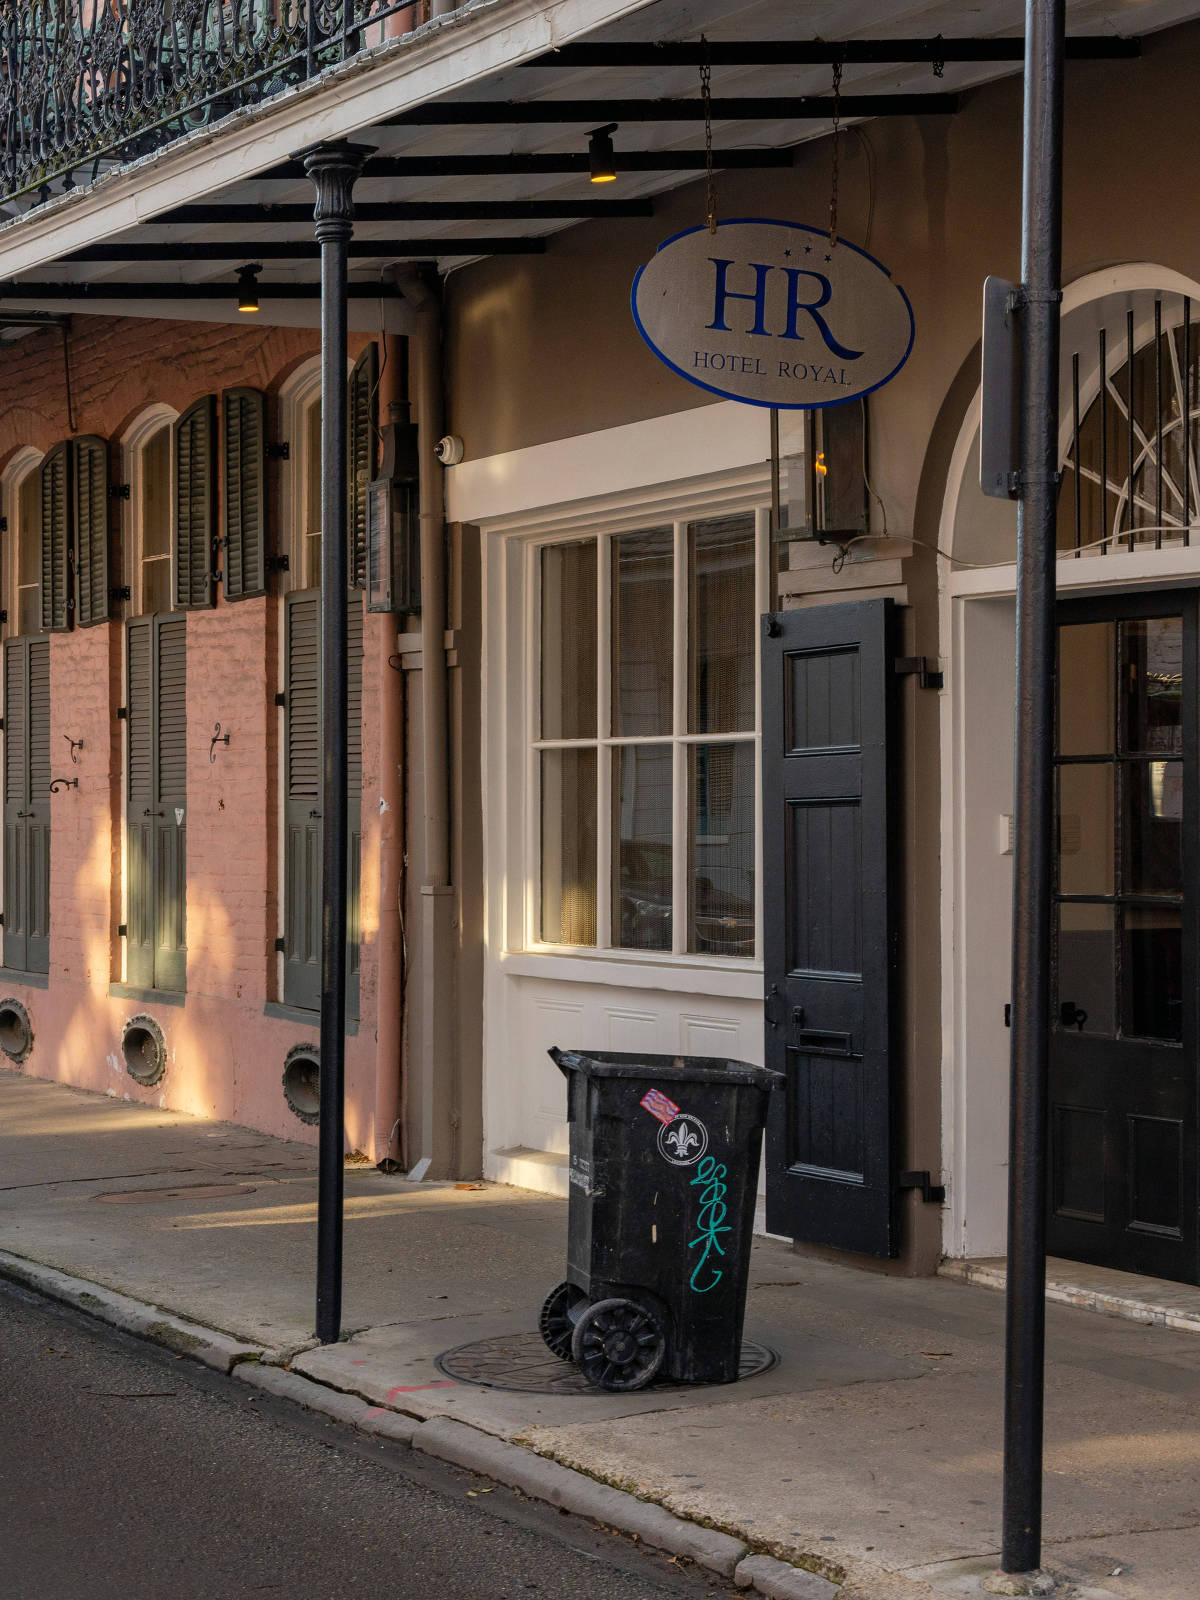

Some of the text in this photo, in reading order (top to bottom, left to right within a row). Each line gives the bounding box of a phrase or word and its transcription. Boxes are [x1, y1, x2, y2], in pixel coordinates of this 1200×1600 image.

[705, 257, 865, 361] HR
[693, 351, 852, 386] HOTEL ROYAL
